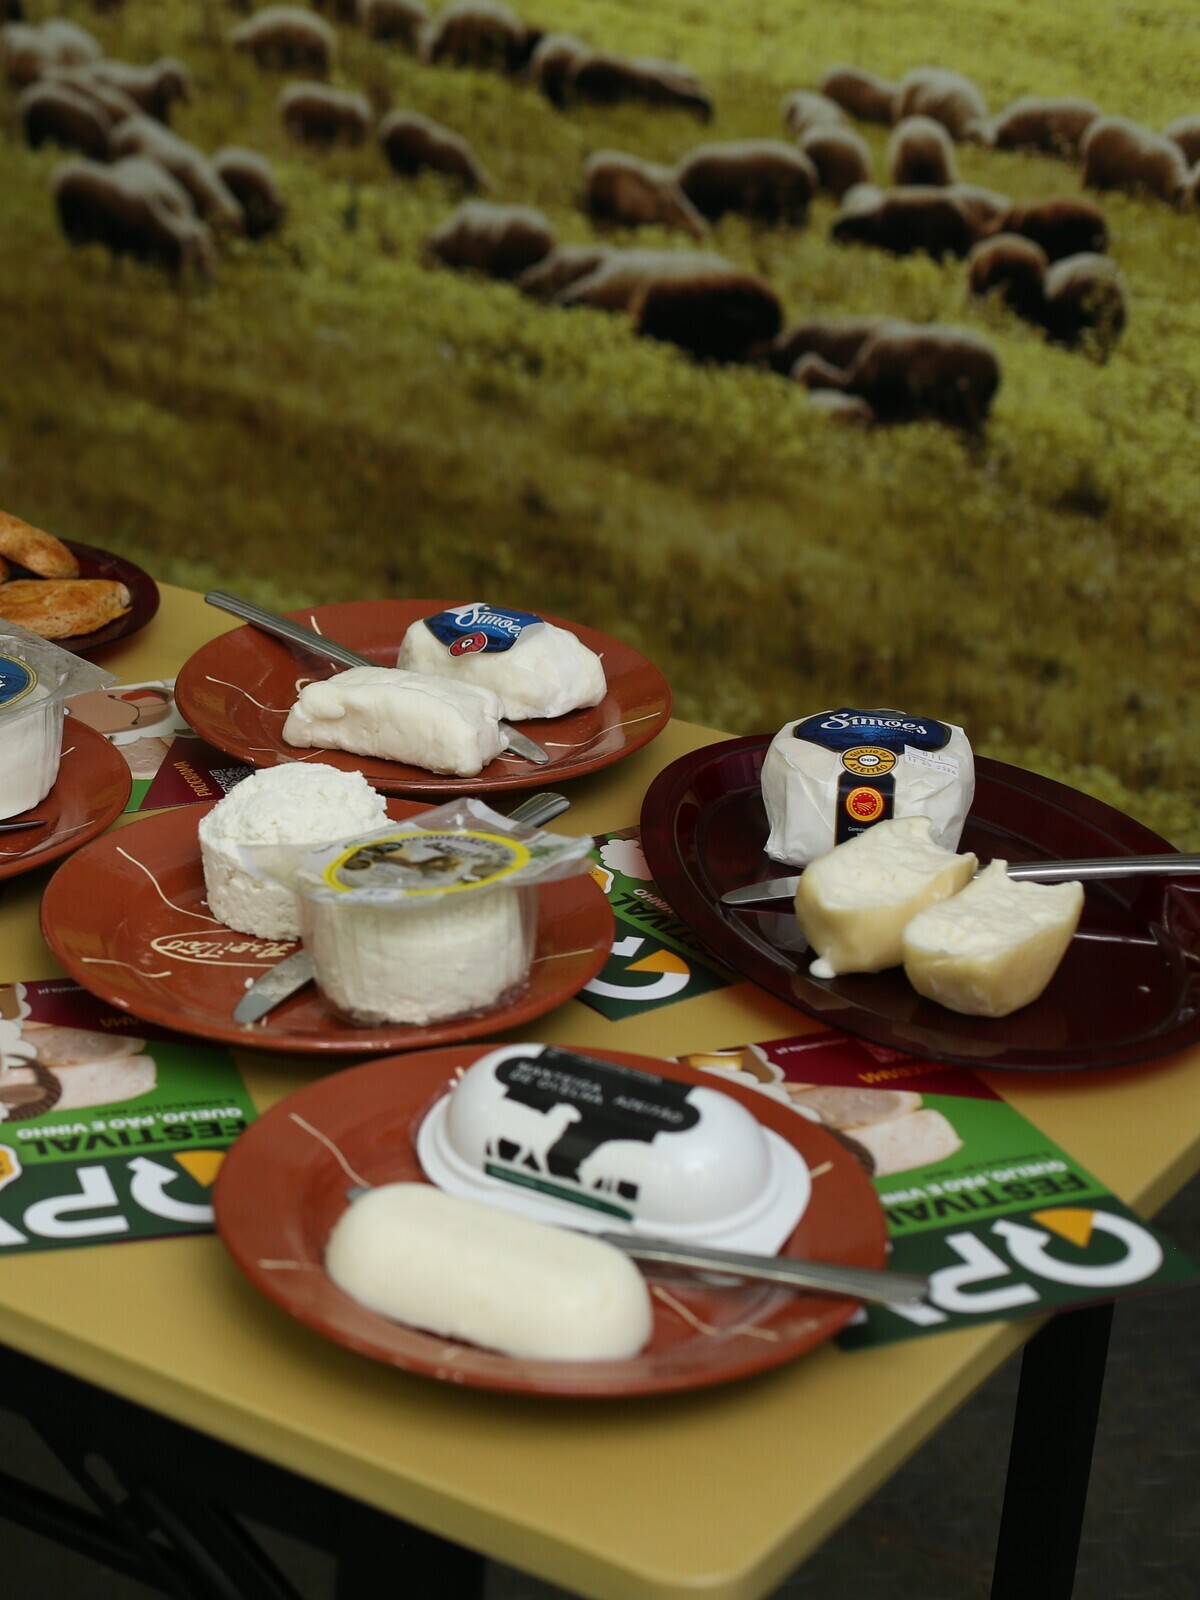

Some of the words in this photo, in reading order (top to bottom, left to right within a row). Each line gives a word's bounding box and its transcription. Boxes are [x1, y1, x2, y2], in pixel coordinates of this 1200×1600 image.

[850, 749, 879, 758] QUEIJO
[879, 750, 891, 759] DE
[848, 762, 888, 774] AZEITÃO
[173, 760, 213, 797] PROGRAMA
[108, 1115, 155, 1132] PÃO
[156, 1107, 243, 1125] QUEIJO,
[16, 1122, 89, 1140] VINHO
[90, 1119, 106, 1131] E
[20, 1118, 249, 1156] FESTIVAL
[943, 1175, 989, 1191] PÃO
